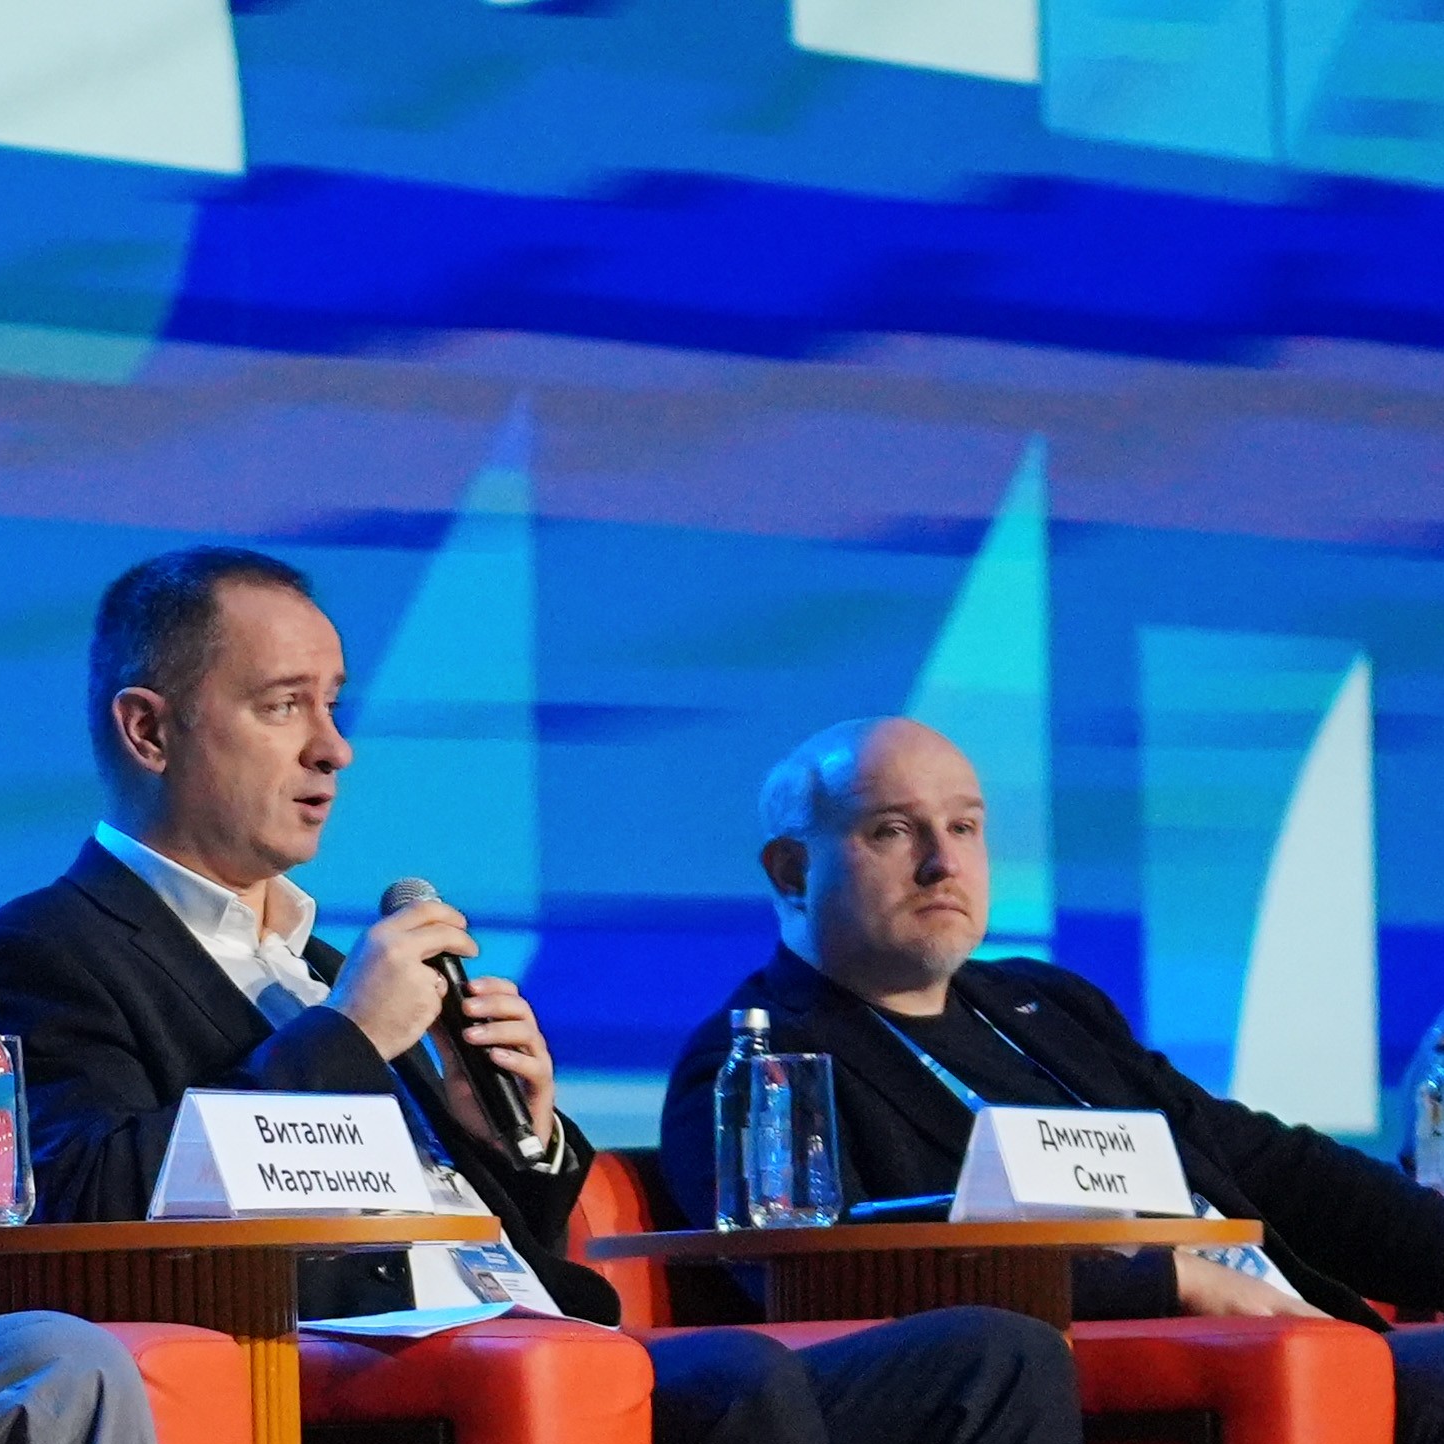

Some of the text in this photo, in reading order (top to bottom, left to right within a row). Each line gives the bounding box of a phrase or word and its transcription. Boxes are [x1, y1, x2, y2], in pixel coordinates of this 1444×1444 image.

[254, 1114, 364, 1145] Виталий
[1037, 1119, 1136, 1157] Дмитрий
[257, 1163, 397, 1196] Мартынюк
[1073, 1164, 1128, 1194] Смит
